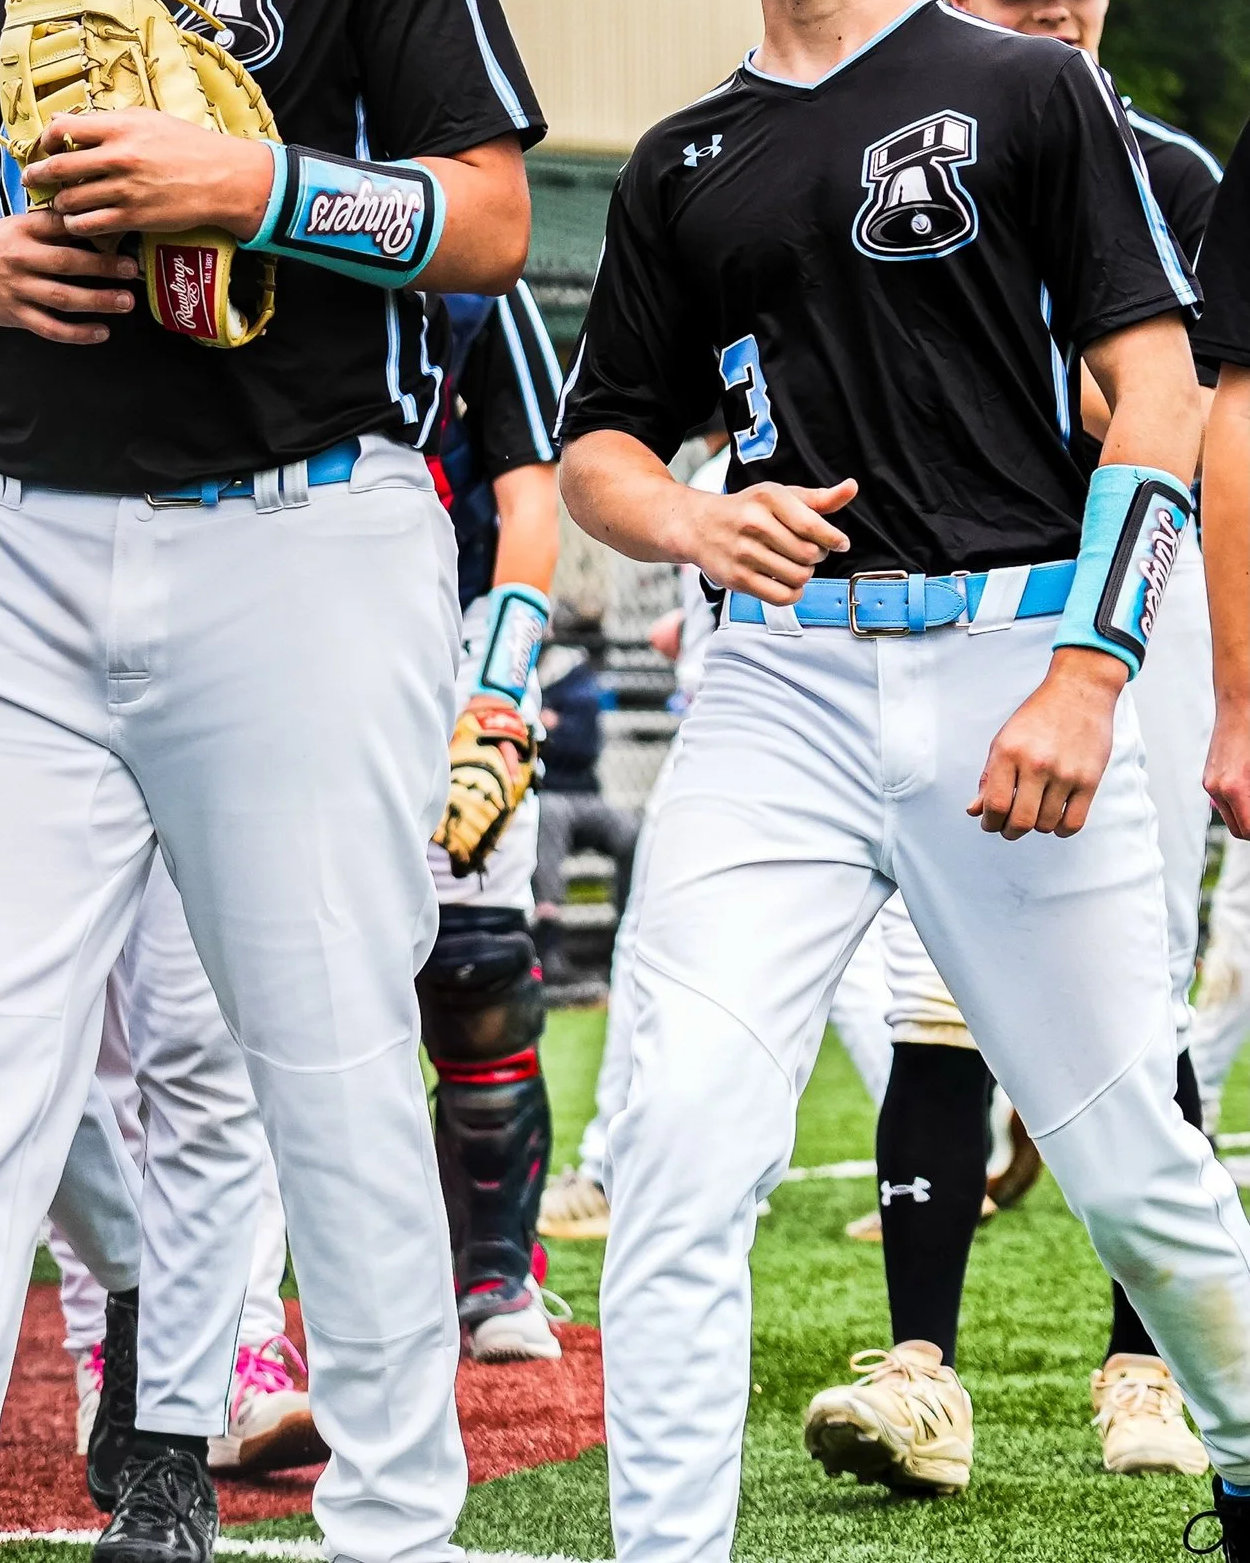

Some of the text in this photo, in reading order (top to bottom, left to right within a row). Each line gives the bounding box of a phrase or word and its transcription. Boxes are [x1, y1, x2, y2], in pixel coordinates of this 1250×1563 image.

[306, 179, 423, 256] Ringers
[169, 254, 197, 330] Rawlings
[719, 333, 779, 465] 3
